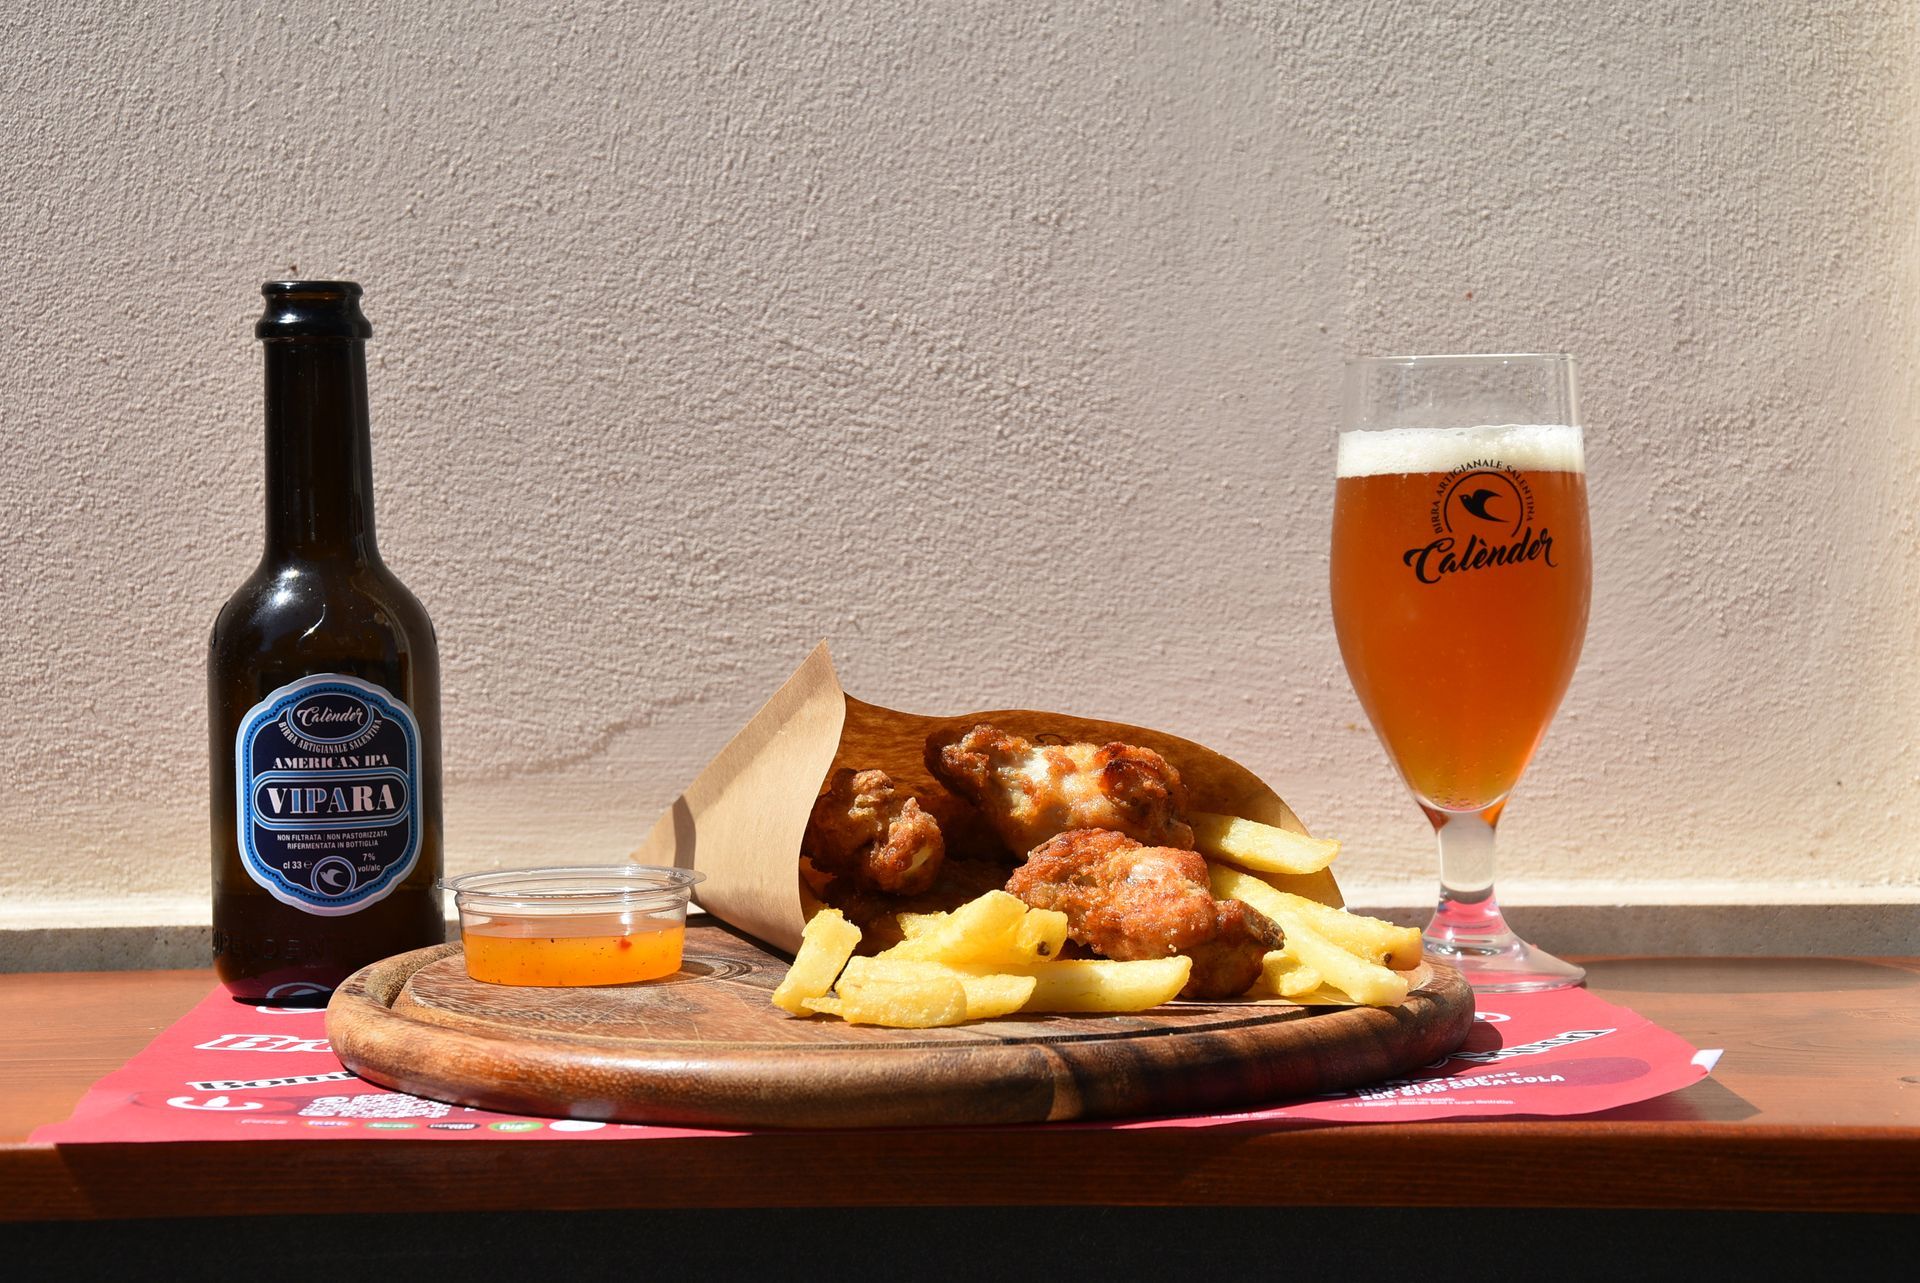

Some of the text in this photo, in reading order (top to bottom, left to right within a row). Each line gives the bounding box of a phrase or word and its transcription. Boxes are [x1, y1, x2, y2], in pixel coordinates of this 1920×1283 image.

[1431, 459, 1535, 534] BIRRA ARTIGIANALE SALENTINA
[1403, 526, 1558, 584] Calènder
[297, 706, 364, 727] Calènder
[278, 719, 382, 754] BIRRA ARTIGIANALE SALENTINA
[272, 753, 389, 769] AMERICAN IPA
[266, 784, 396, 814] VIPARA
[326, 833, 341, 841] NON
[342, 830, 388, 840] PASTORIZZATA
[287, 842, 336, 850] RIFERMENTATA
[345, 840, 379, 848] BOTTIGLIA
[291, 861, 302, 869] 33
[362, 853, 376, 861] 7%
[357, 864, 381, 872] vol/alc
